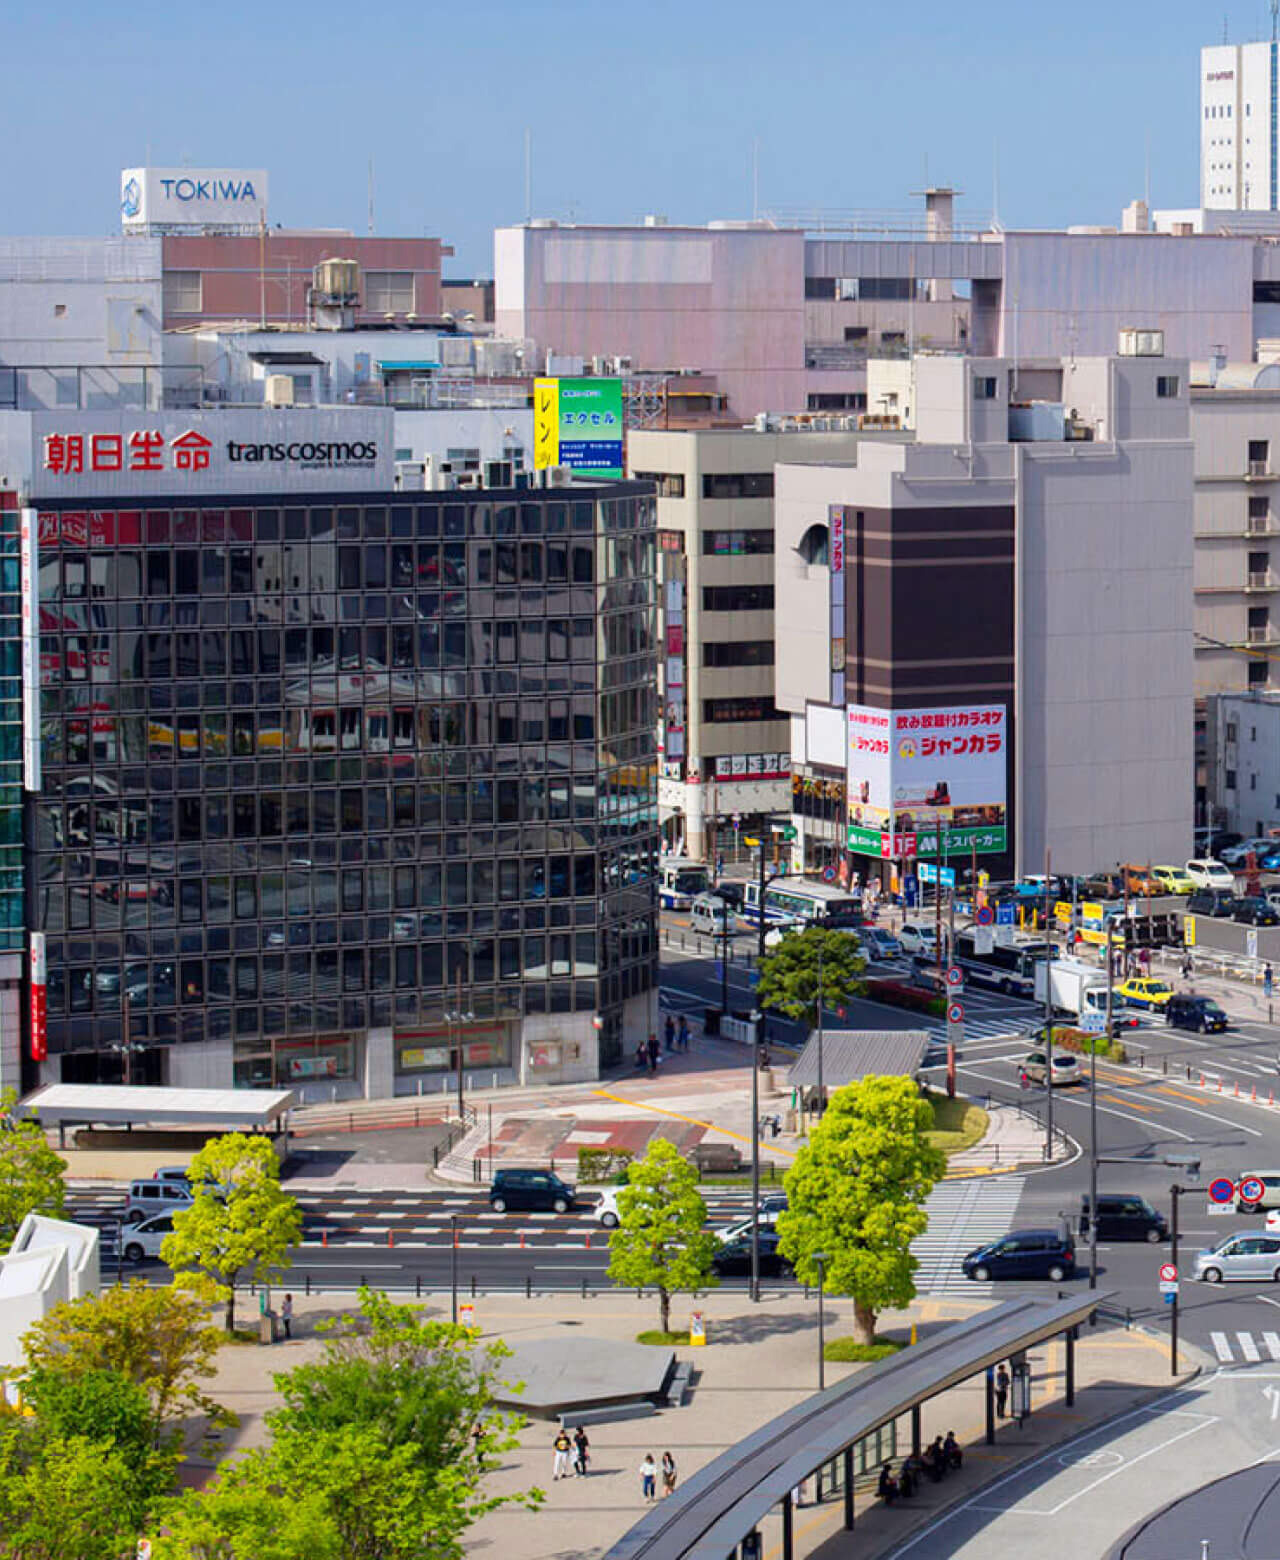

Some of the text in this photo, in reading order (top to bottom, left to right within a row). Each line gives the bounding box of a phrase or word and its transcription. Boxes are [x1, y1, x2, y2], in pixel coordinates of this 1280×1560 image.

[160, 178, 257, 203] TOKIWA
[562, 411, 617, 427] エクセル
[44, 430, 213, 474] 朝日生命
[226, 440, 378, 464] transcosmos
[921, 733, 1002, 756] ジャンカラ
